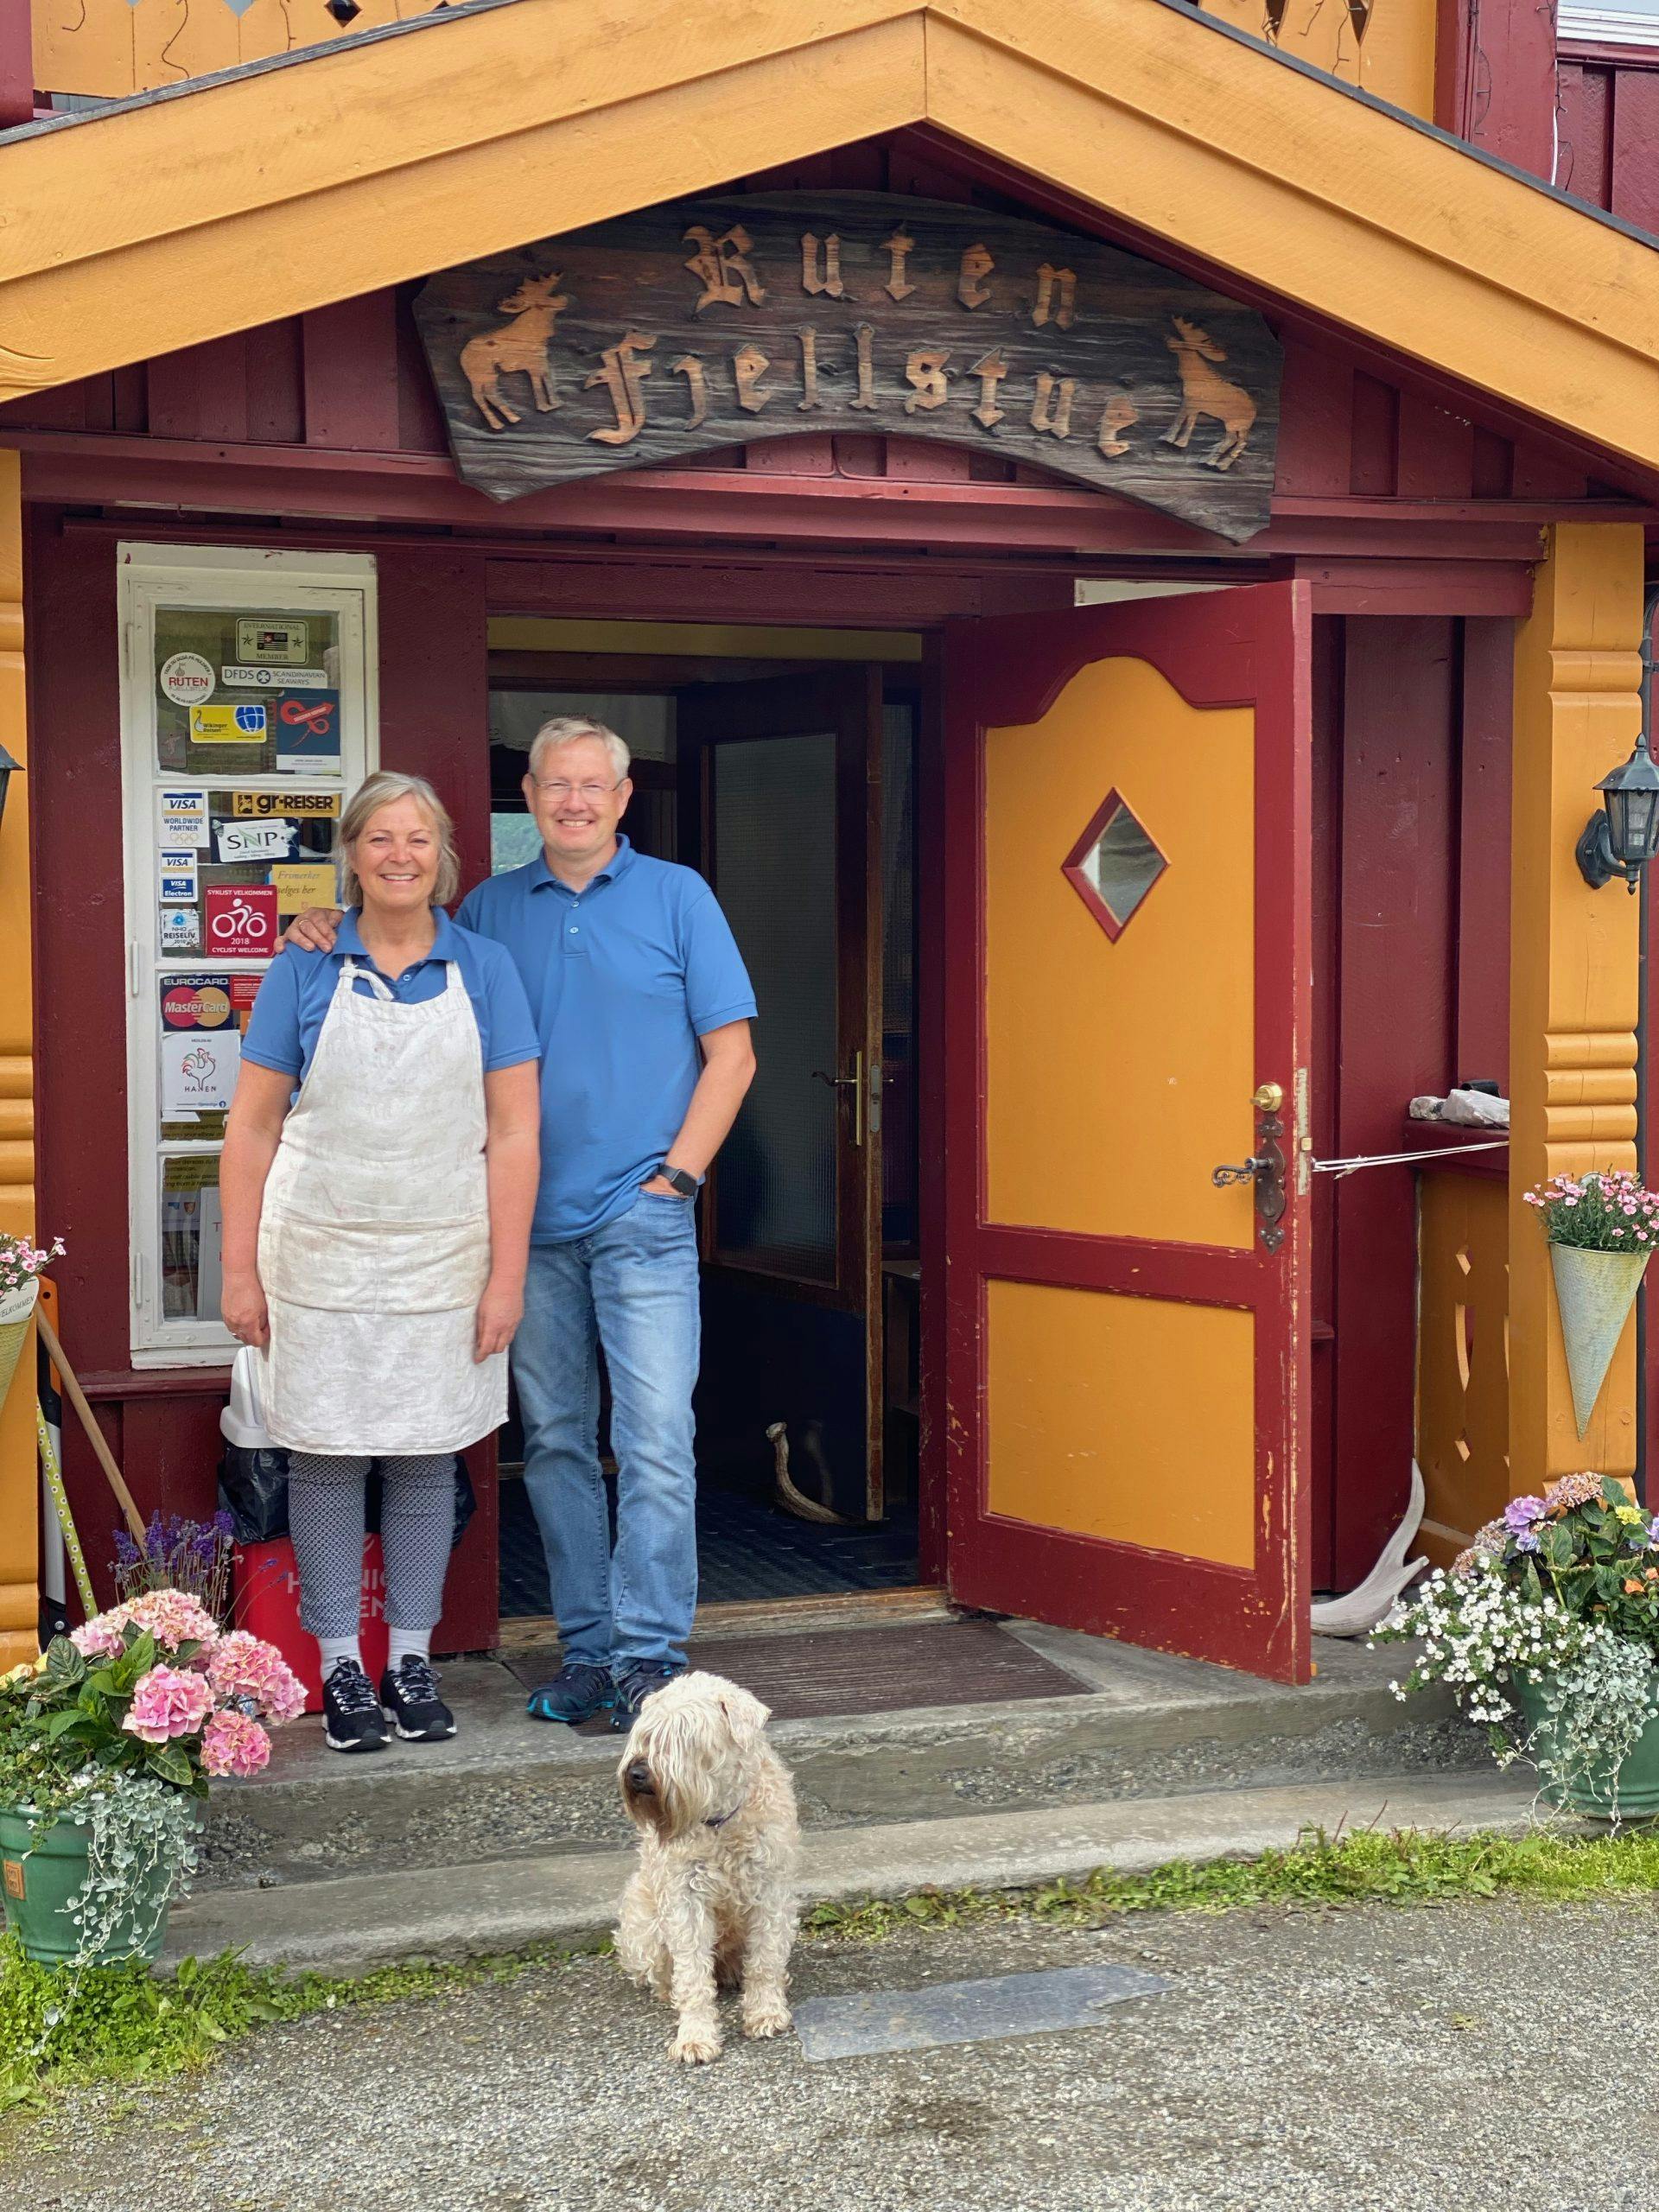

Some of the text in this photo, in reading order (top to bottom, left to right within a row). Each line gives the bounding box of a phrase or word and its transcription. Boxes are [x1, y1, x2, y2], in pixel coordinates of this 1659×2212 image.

[681, 221, 1078, 330] Ruten
[224, 669, 254, 680] DFDS
[168, 677, 208, 687] RUTEN
[169, 799, 196, 810] VISA
[167, 858, 188, 867] VISA
[302, 885, 316, 894] her
[164, 977, 229, 986] EUROCARD
[164, 1001, 228, 1014] MasterCard
